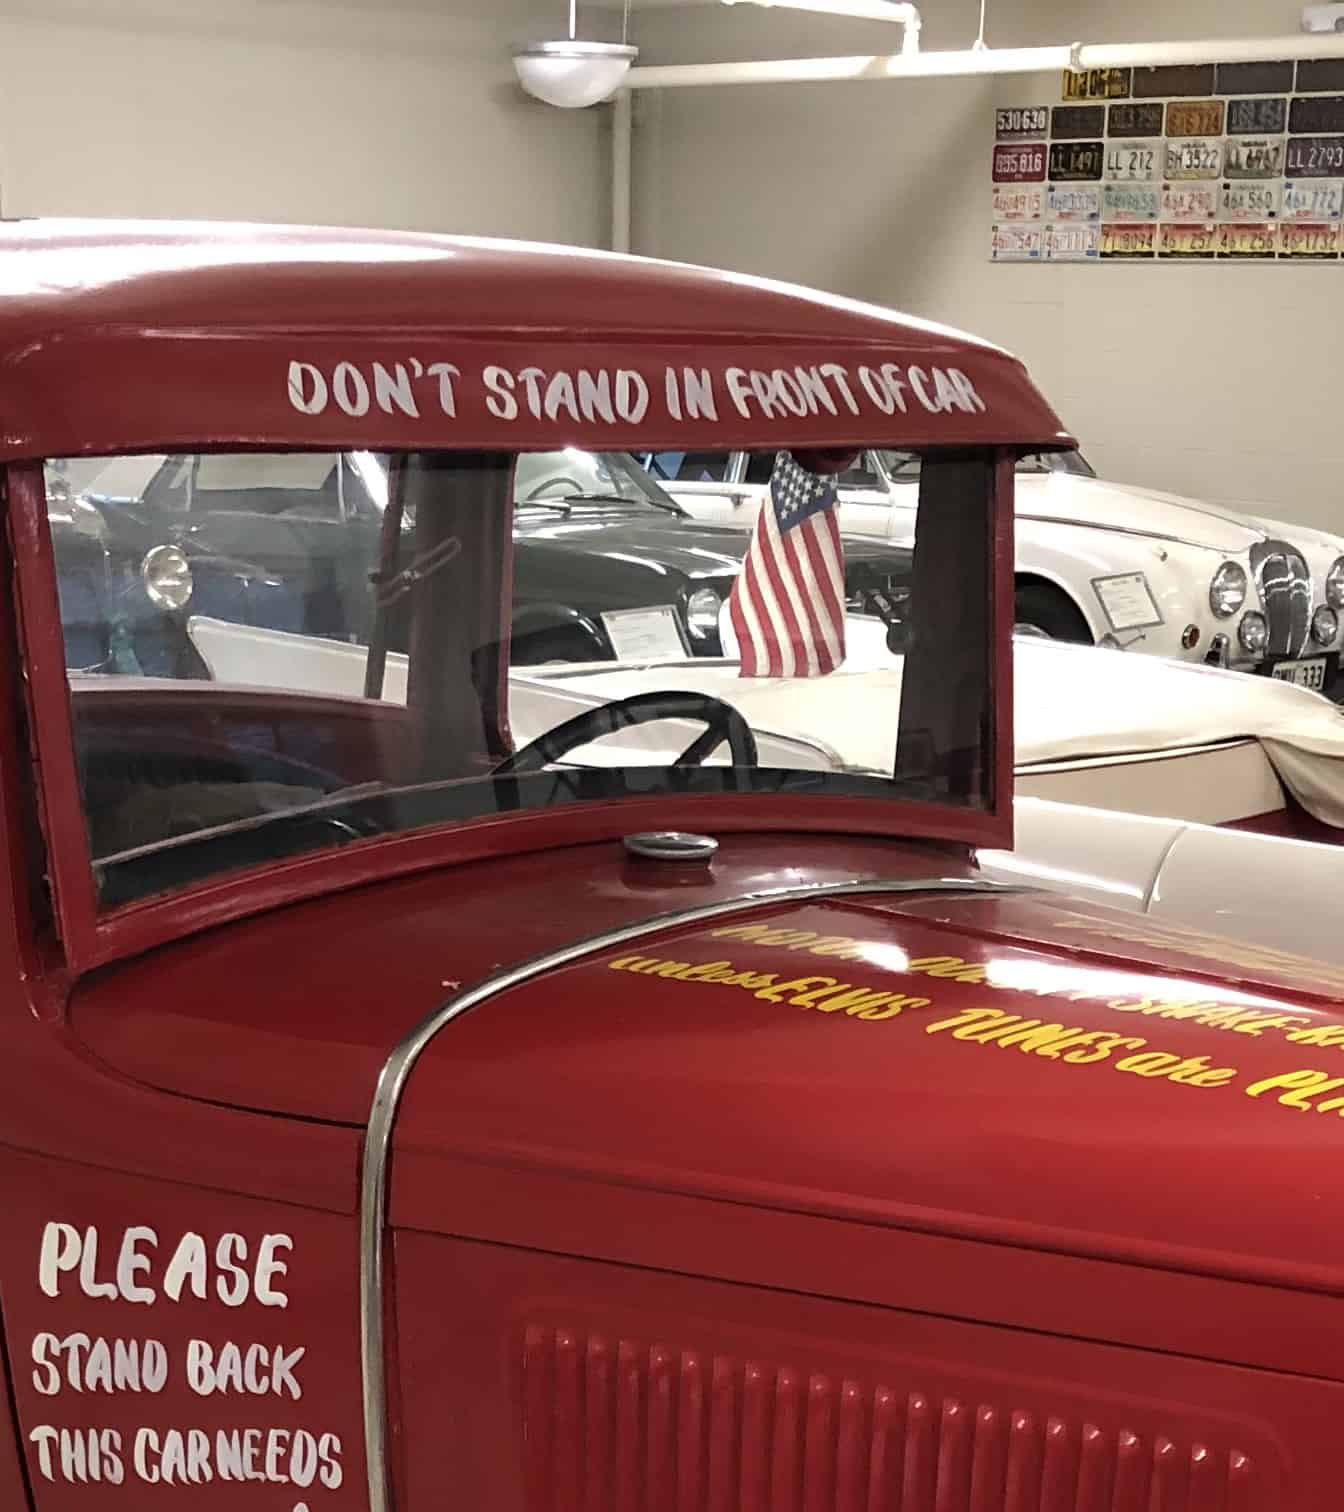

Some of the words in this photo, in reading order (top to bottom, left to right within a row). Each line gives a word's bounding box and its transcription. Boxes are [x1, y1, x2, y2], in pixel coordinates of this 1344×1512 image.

[288, 358, 460, 419] DON'T
[483, 366, 649, 425] STAND
[666, 366, 719, 422] IN
[728, 363, 861, 419] FRONT
[862, 363, 917, 415] OF
[917, 366, 987, 413] CAR
[754, 975, 931, 1021] ELVIS
[926, 1008, 1147, 1064] TUNES
[39, 1221, 294, 1309] PLEASE
[31, 1332, 168, 1395] STAND
[186, 1338, 306, 1401] BACK
[29, 1424, 124, 1486] THIS
[134, 1427, 213, 1486] CAR
[216, 1428, 343, 1490] NEEDS
